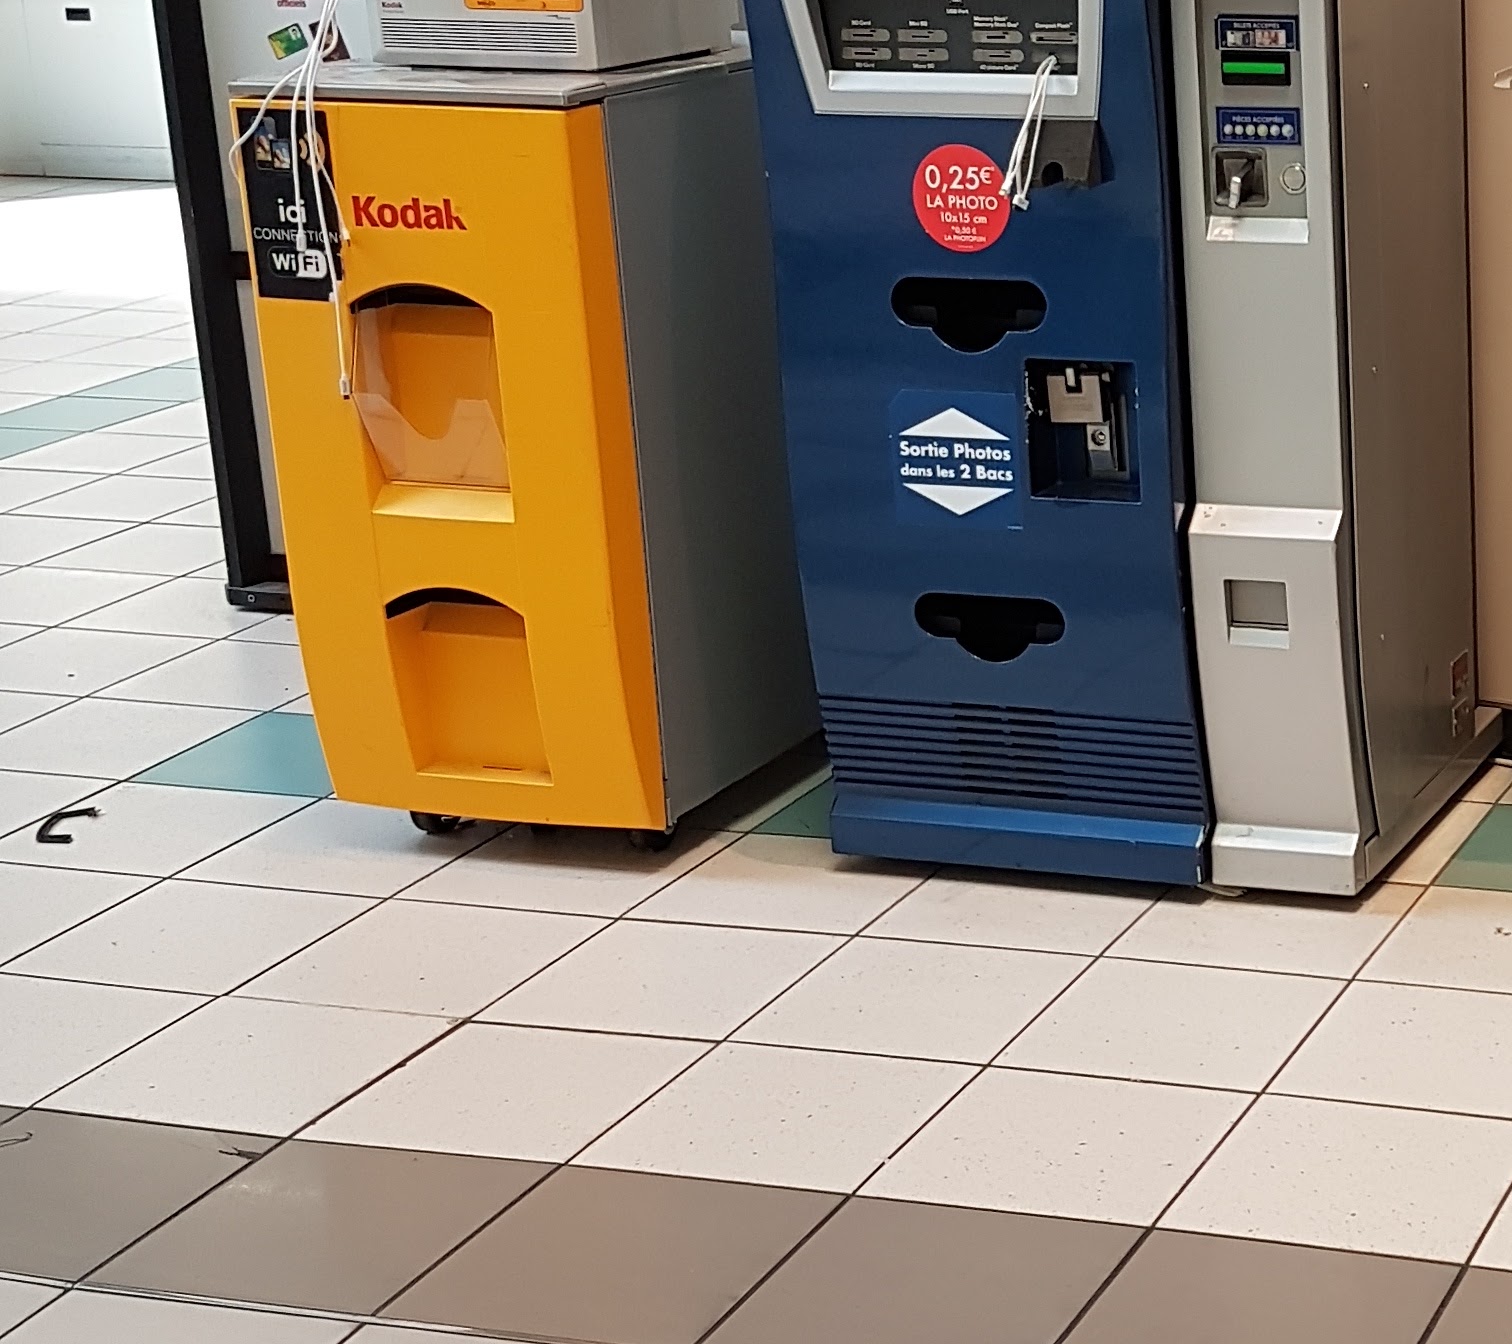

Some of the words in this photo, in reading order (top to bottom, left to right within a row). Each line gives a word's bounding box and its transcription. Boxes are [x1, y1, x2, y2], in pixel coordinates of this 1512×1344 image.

[277, 198, 307, 223] ici
[926, 194, 944, 208] LA
[948, 195, 998, 210] PHOTO
[351, 195, 467, 231] Kodak
[940, 211, 970, 223] 10x15
[973, 216, 987, 224] cm
[899, 440, 949, 459] Sortie
[954, 442, 1011, 462] Photos
[900, 464, 933, 479] dans
[936, 465, 955, 479] les
[960, 465, 971, 480] 2
[975, 465, 1014, 482] Bacs
